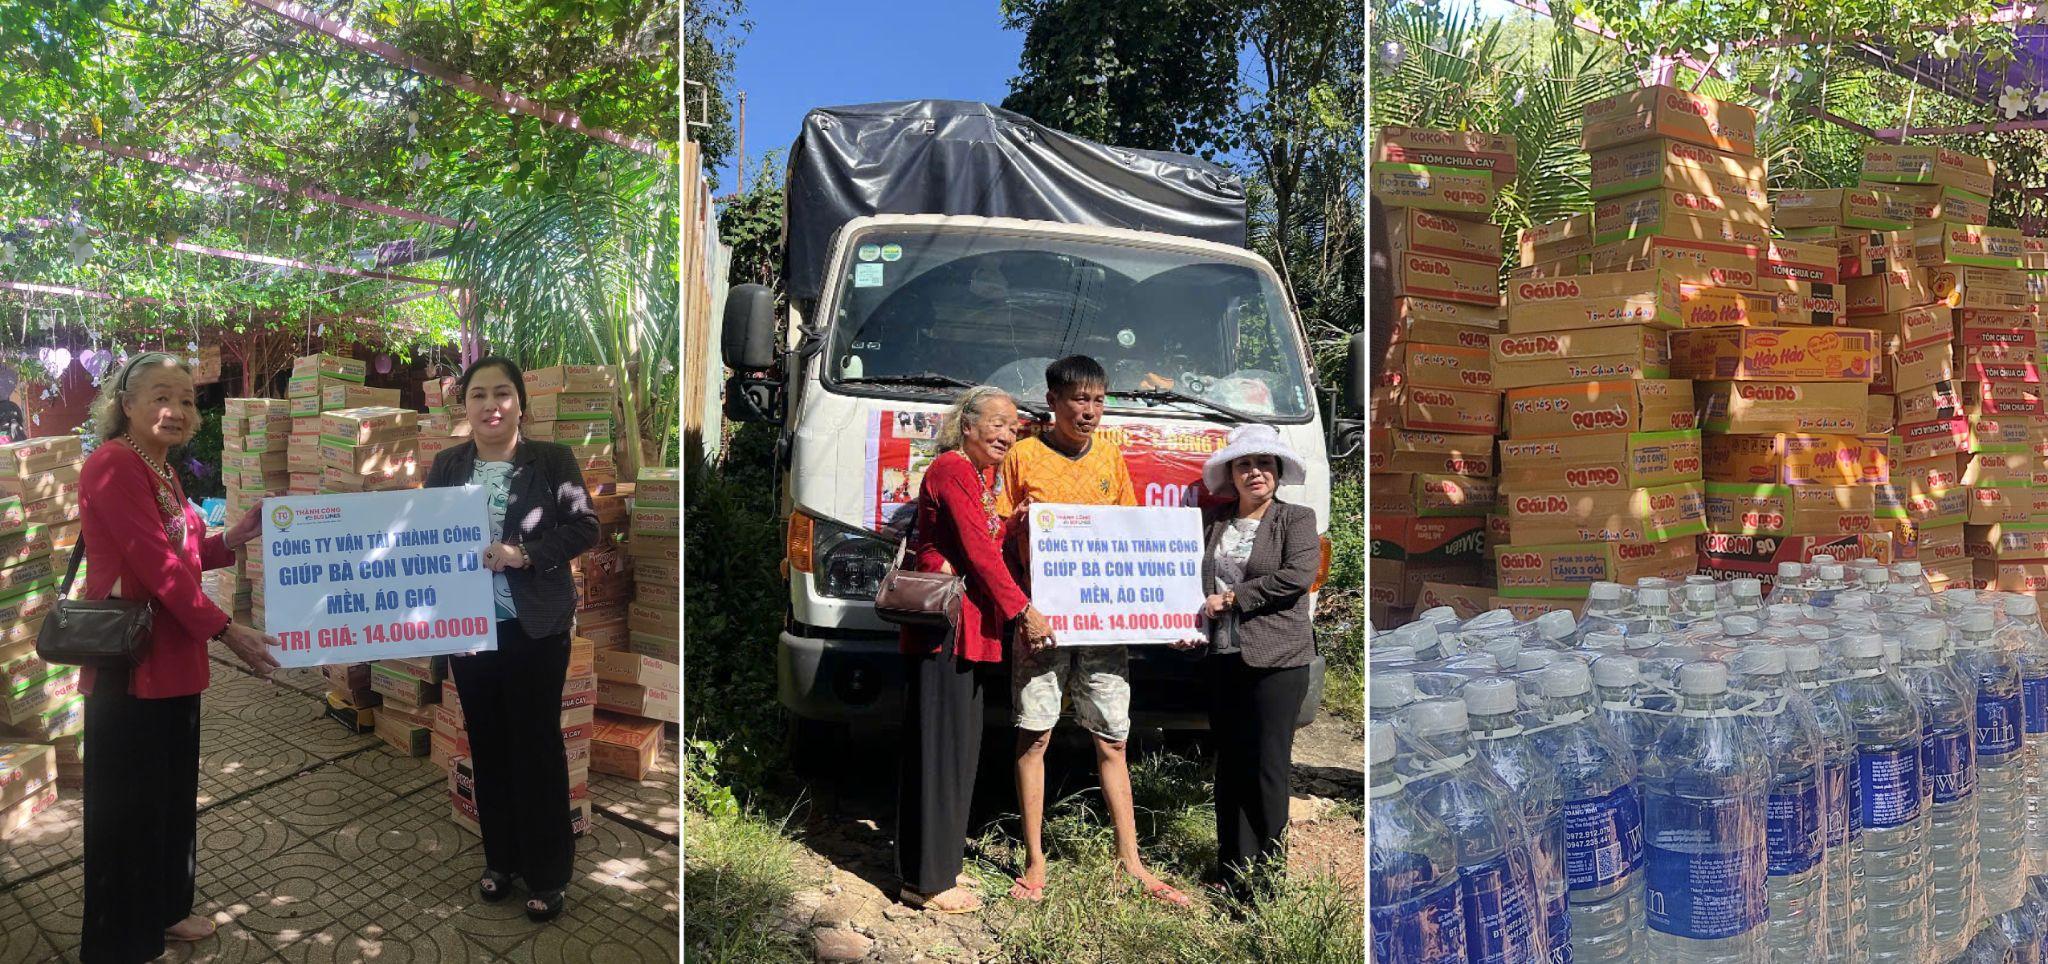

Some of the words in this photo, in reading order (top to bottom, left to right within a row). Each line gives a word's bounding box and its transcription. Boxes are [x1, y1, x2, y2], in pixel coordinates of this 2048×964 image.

[1420, 153, 1443, 163] TÔM
[1445, 156, 1473, 166] CHUA
[1475, 158, 1495, 168] CAY
[1772, 264, 1789, 275] TÔM
[1789, 267, 1809, 279] CHUA
[1809, 269, 1824, 280] CAY
[1691, 304, 1717, 323] Hảo
[1982, 333, 1995, 341] TÔM
[1996, 334, 2012, 342] CHUA
[2013, 334, 2024, 342] CAY
[1754, 349, 1778, 369] Hảo
[1780, 344, 1805, 364] Hảo
[1985, 369, 1999, 377] TÔM
[1999, 369, 2016, 378] CHUA
[2016, 370, 2028, 378] CAY
[1999, 403, 2011, 411] TÔM
[2011, 403, 2025, 411] CHUA
[2025, 404, 2035, 412] CAY
[272, 540, 311, 557] CÔNG
[315, 538, 332, 553] TY
[336, 532, 364, 554] VẬN
[367, 530, 390, 550] TẢI
[393, 526, 439, 548] THÀNH
[443, 526, 482, 544] CÔNG
[1038, 538, 1068, 552] CÔNG
[1071, 540, 1084, 553] TY
[1087, 538, 1109, 555] VẬN
[1131, 538, 1166, 553] THÀNH
[1169, 539, 1198, 553] CÔNG
[1757, 539, 1776, 555] 90
[279, 563, 323, 586] GIÚP
[328, 559, 354, 583] BÀ
[359, 558, 397, 580] CON
[401, 553, 451, 577] VÙNG
[457, 550, 479, 573] LŨ
[1043, 560, 1077, 577] GIÚP
[1082, 560, 1101, 577] BÀ
[1105, 561, 1134, 577] CON
[1137, 559, 1176, 577] VÙNG
[1181, 558, 1196, 577] LŨ
[1553, 566, 1578, 578] TẶNG
[1579, 566, 1585, 576] 3
[1587, 564, 1604, 576] GÓI
[1699, 567, 1723, 581] TÔM
[1757, 572, 1779, 586] CAY
[327, 588, 370, 615] MỀN,
[373, 587, 399, 611] ÁO
[405, 585, 437, 608] GIÓ
[1080, 583, 1113, 604] MỀN,
[1117, 585, 1136, 603] ÁO
[1140, 585, 1164, 603] GIÓ
[1073, 612, 1103, 631] GIÁ:
[277, 631, 312, 653] TRỊ
[317, 625, 357, 648] GIÁ:
[362, 616, 489, 645] 14.000.000Đ
